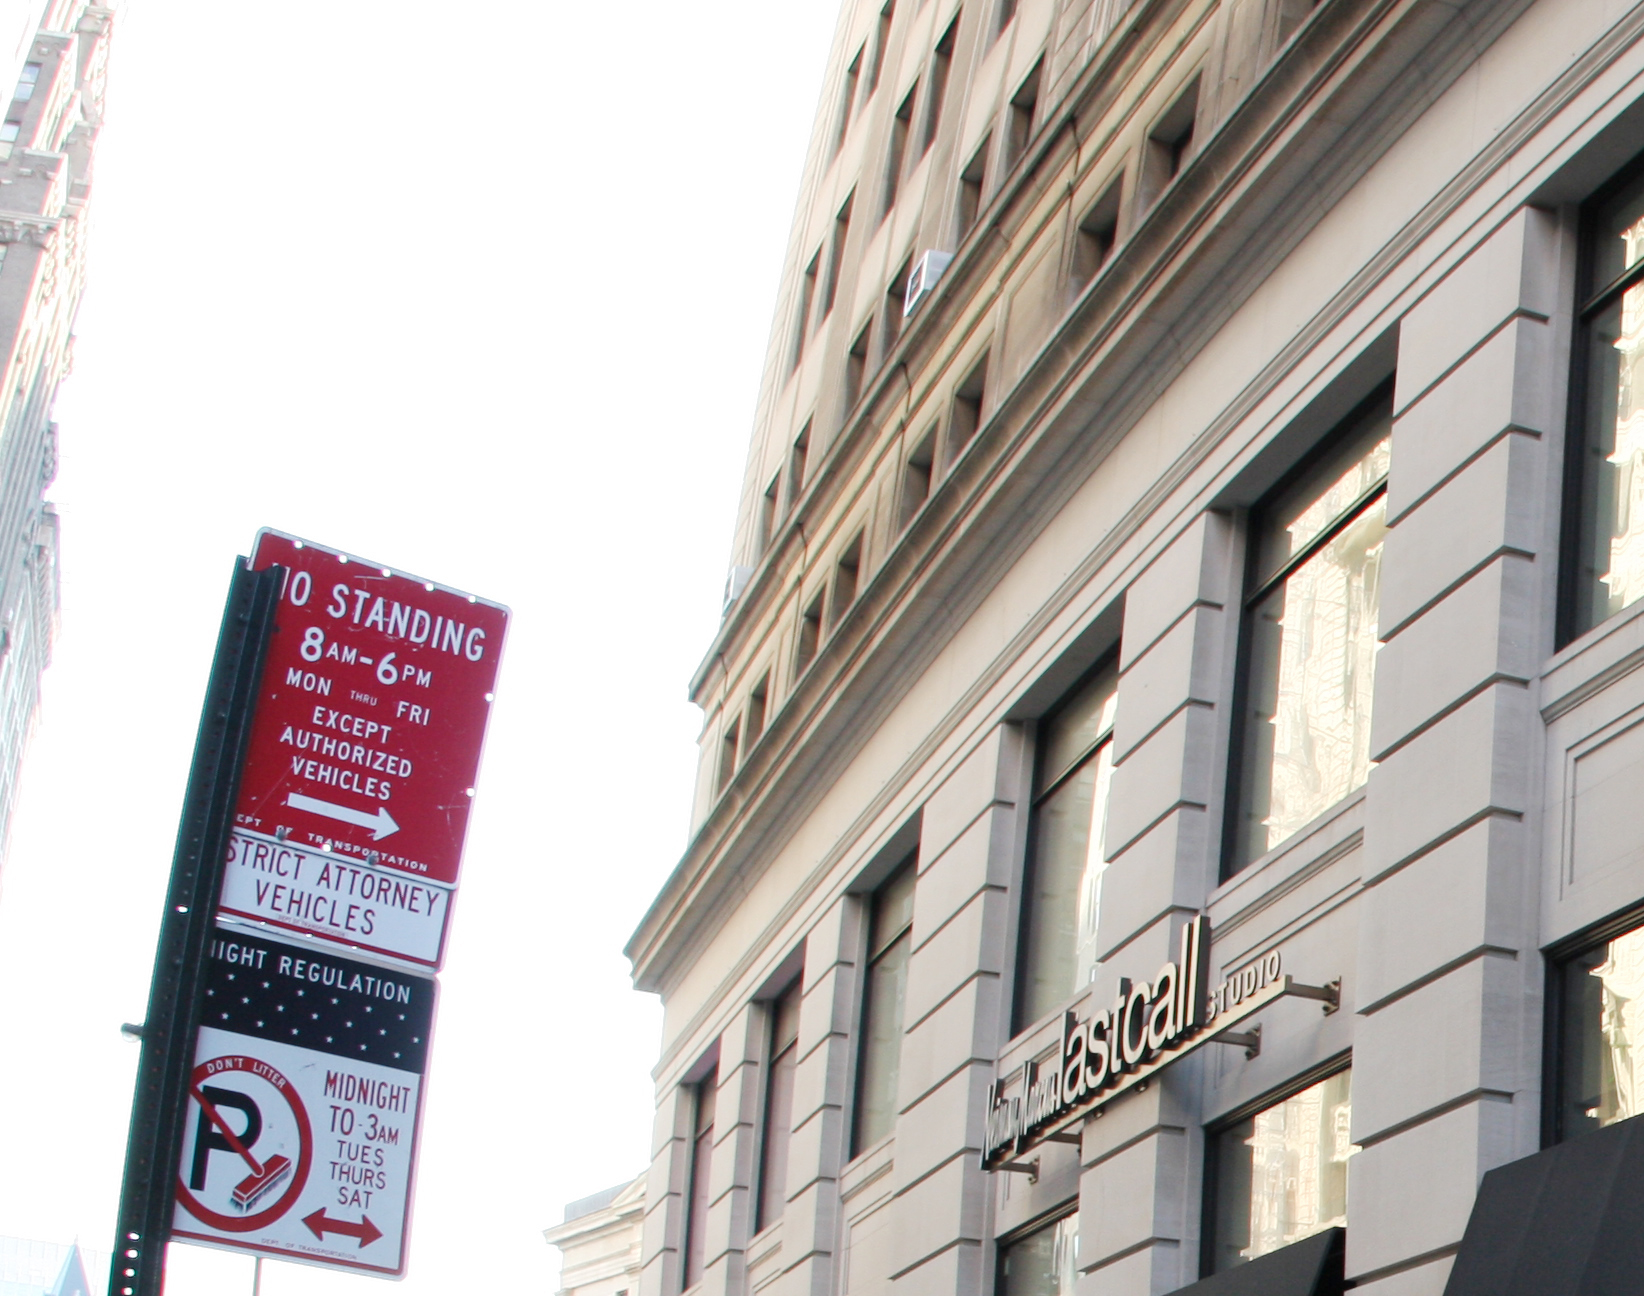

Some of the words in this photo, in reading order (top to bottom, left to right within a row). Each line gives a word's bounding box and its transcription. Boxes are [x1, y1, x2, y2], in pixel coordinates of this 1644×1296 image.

[327, 584, 486, 661] STANDING
[285, 667, 332, 697] MON
[350, 690, 378, 706] THRU
[396, 701, 430, 726] FRI
[312, 706, 392, 743] EXCEPT
[279, 726, 412, 778] AUTHORIZED
[291, 757, 392, 800] VEHICLES
[236, 814, 262, 827] EPT
[308, 833, 429, 872] TRANSPORTATION
[227, 838, 306, 880] STRICT
[316, 862, 440, 917] ATTORNEY
[255, 879, 376, 936] VEHICLES
[279, 956, 411, 1005] REGULATION
[1206, 949, 1281, 1023] STUDIO
[206, 1058, 244, 1074] DON'T
[253, 1059, 287, 1089] LITTER
[324, 1069, 411, 1114] MIDNIGHT
[330, 1162, 386, 1190] THURS
[337, 1140, 384, 1167] TUES
[337, 1187, 373, 1209] SAT
